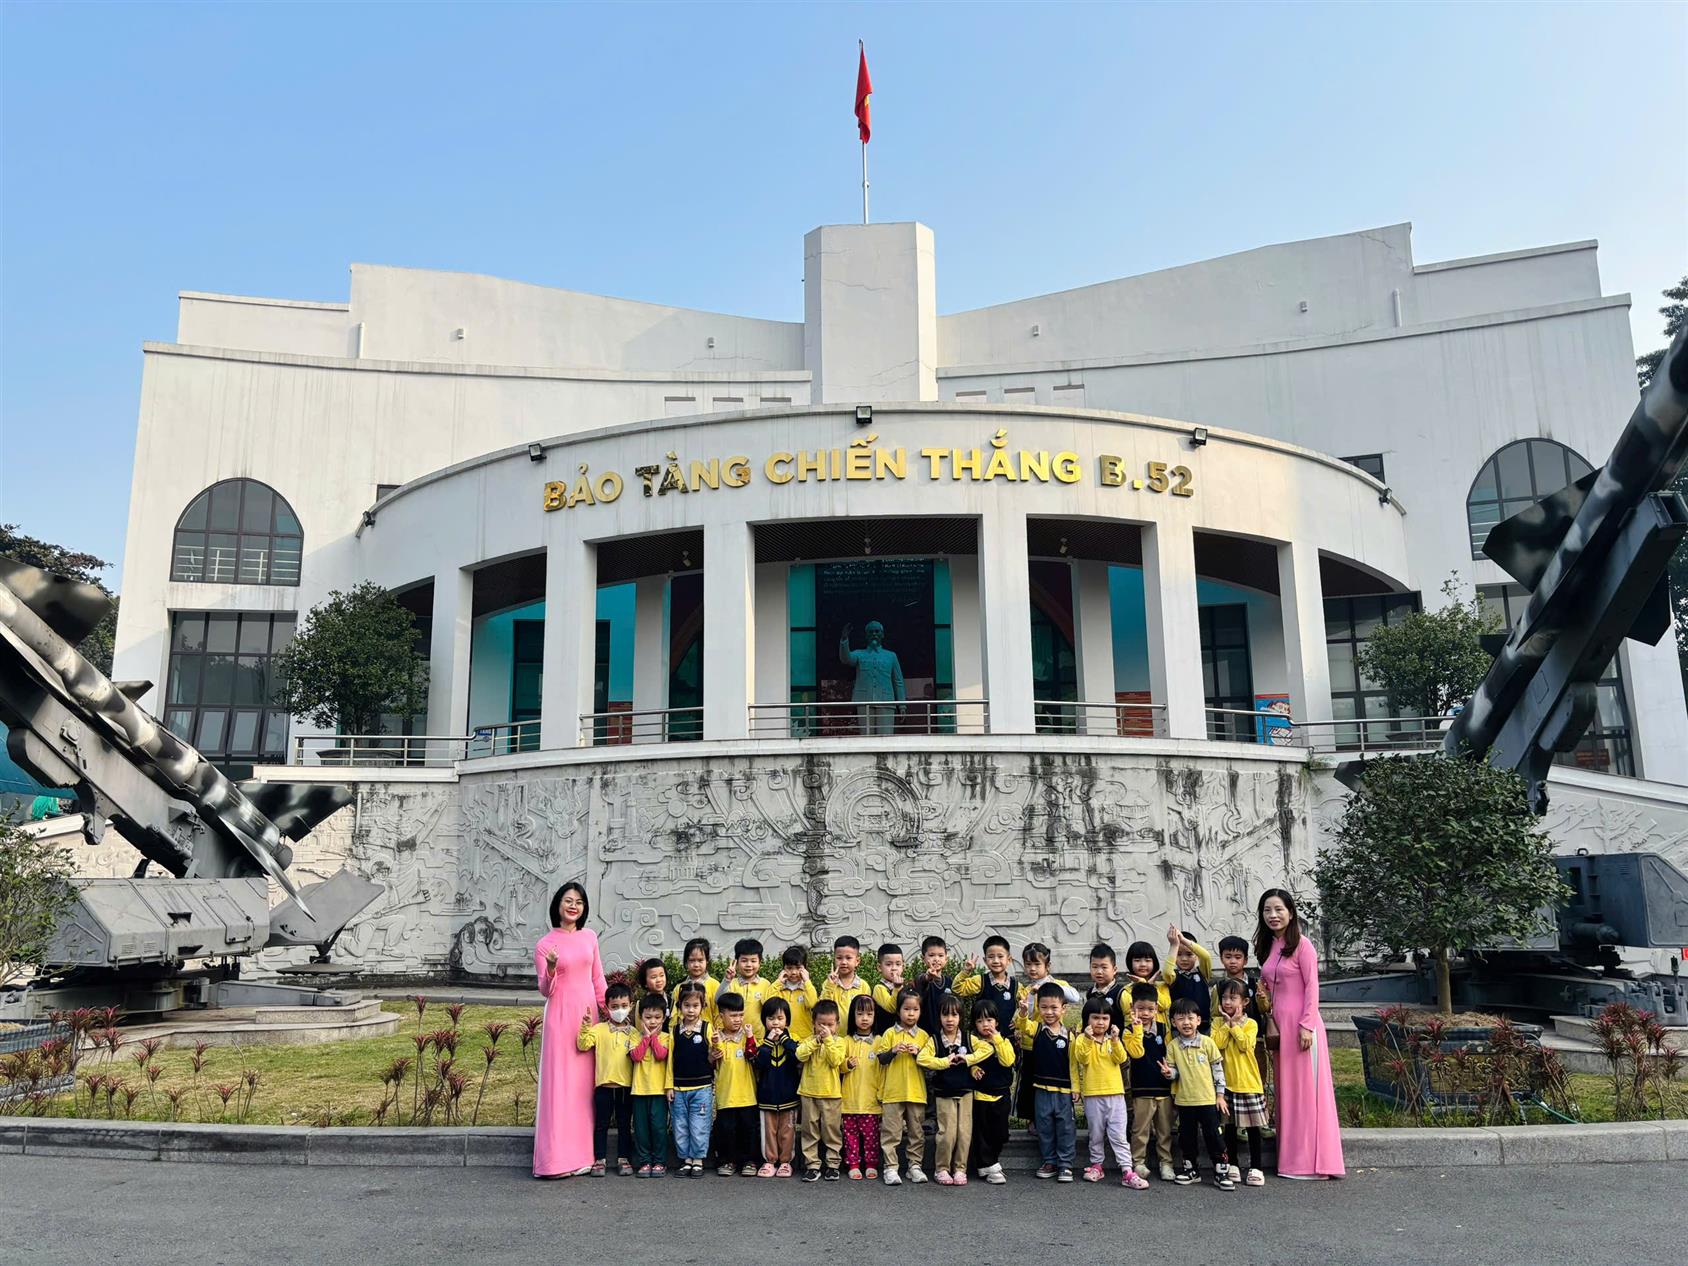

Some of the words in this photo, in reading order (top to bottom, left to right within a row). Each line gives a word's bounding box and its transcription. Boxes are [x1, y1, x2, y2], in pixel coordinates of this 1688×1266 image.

[543, 464, 624, 512] BẢO
[635, 451, 750, 497] TÀNG
[764, 434, 906, 484] CHIẾN
[921, 428, 1080, 482] THẮNG
[1099, 454, 1194, 497] B.52
